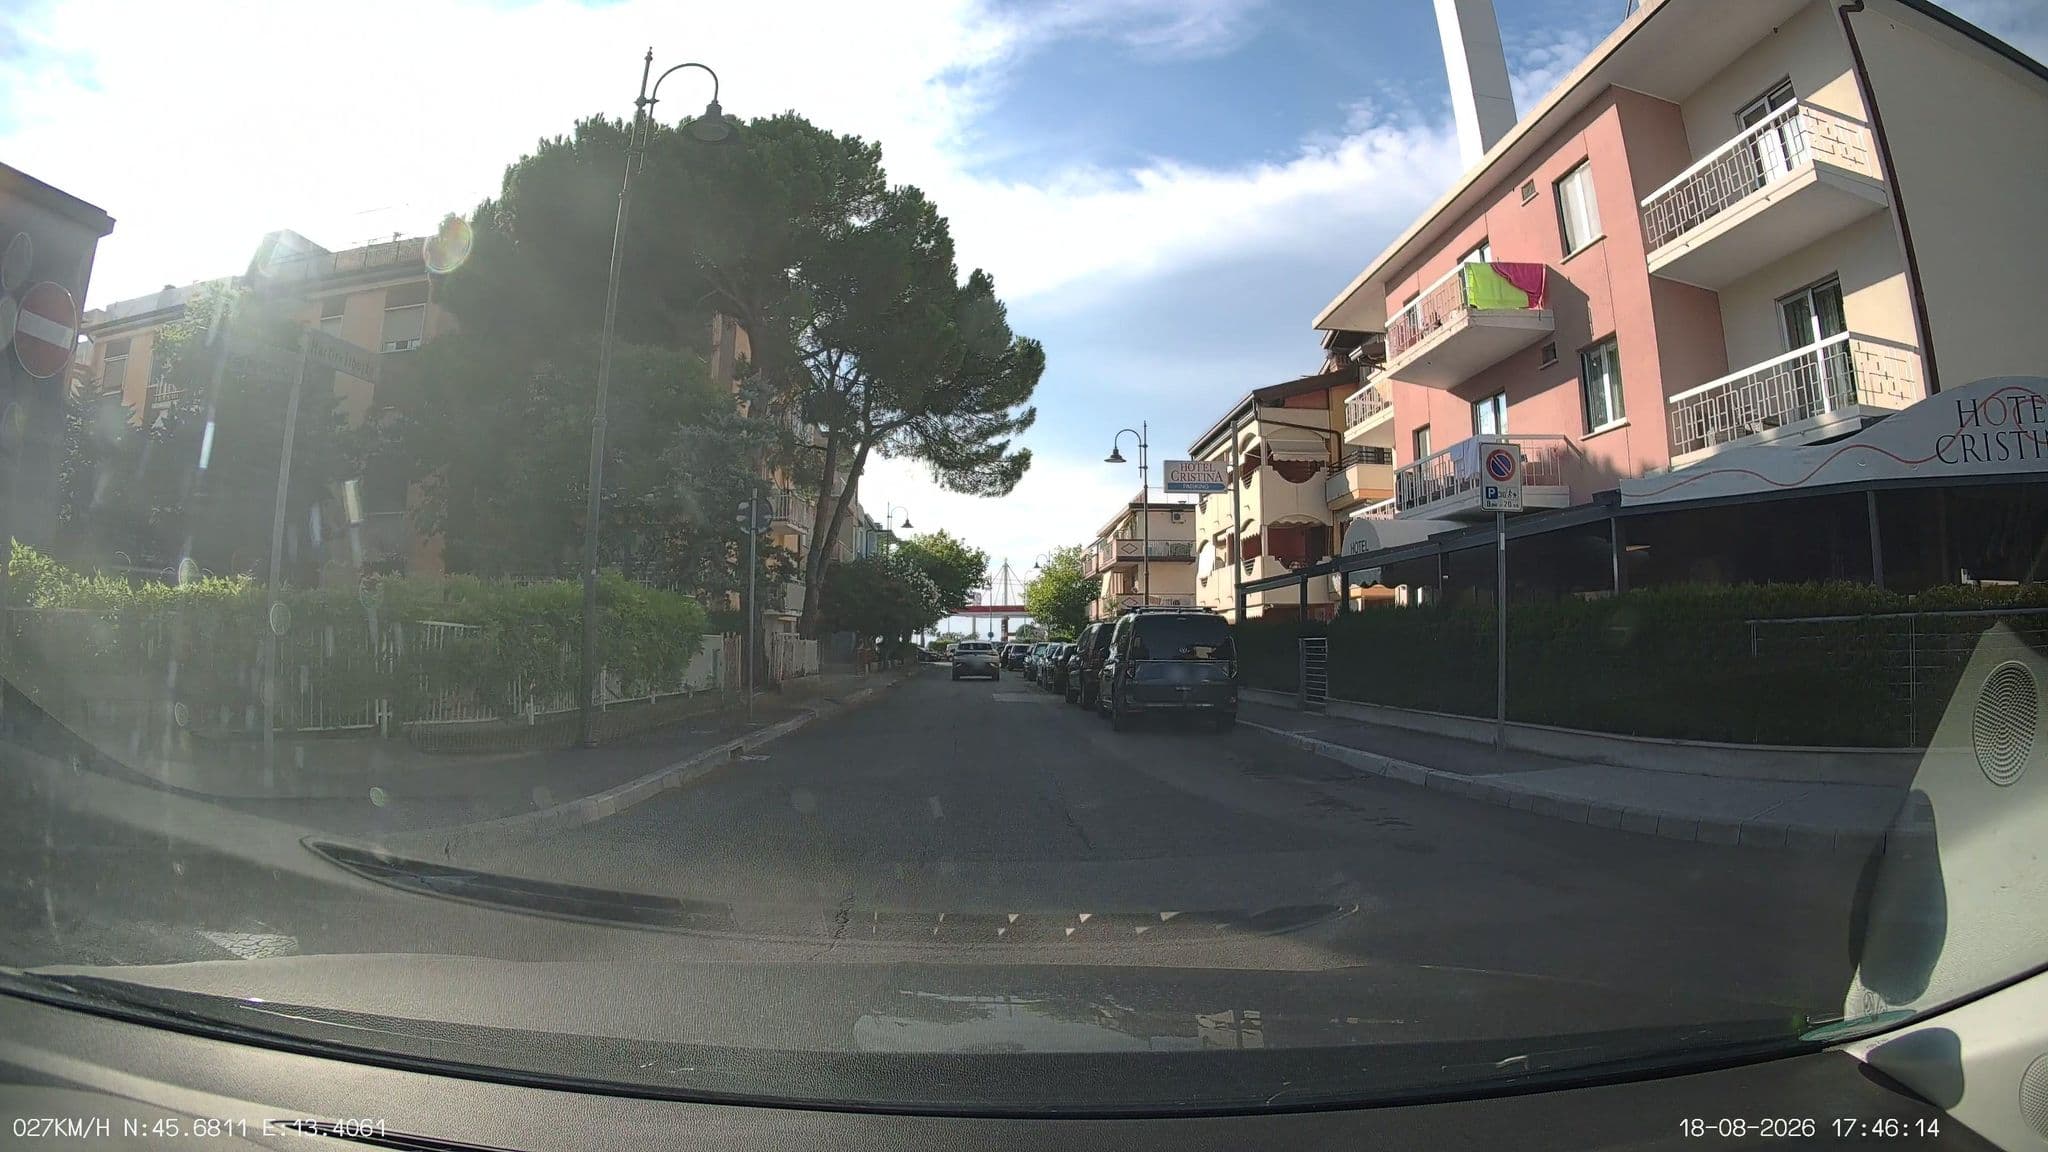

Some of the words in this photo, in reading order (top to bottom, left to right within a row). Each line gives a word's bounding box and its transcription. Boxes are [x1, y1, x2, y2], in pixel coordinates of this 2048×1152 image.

[1957, 394, 2048, 427] HOTE
[1936, 429, 2048, 464] CRISTI
[1180, 463, 1216, 472] HOTEL
[1171, 470, 1223, 482] CRISTINA
[1350, 540, 1368, 555] HOTEL
